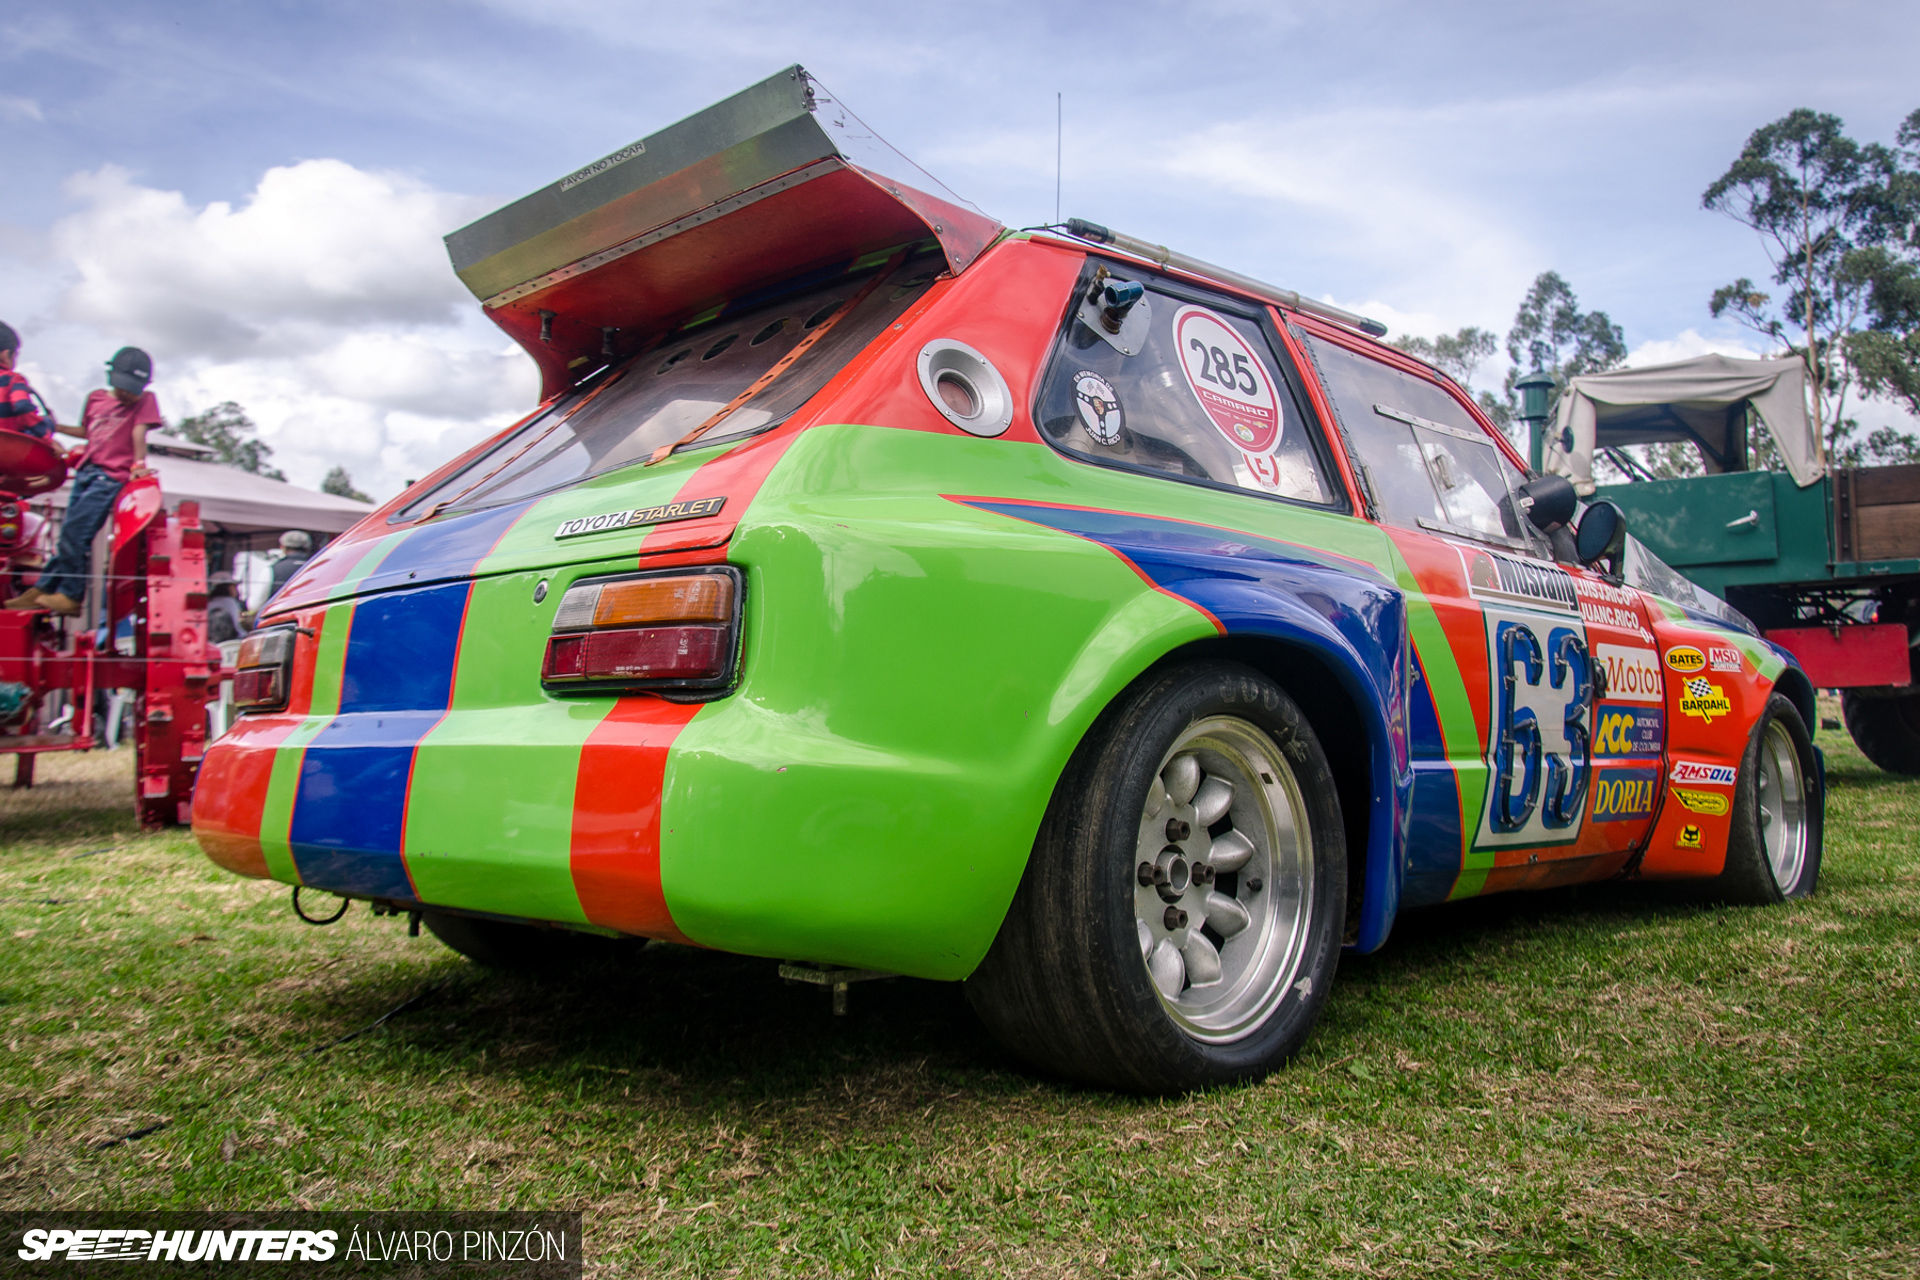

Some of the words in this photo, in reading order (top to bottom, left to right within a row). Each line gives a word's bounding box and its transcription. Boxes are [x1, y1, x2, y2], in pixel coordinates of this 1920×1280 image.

[561, 169, 592, 188] FAVOR
[592, 160, 608, 173] NO
[609, 143, 643, 164] TOCAR
[1190, 338, 1257, 396] 285
[1202, 391, 1269, 418] CAMARO
[1085, 427, 1101, 443] JUAN
[1108, 433, 1121, 445] RICO
[561, 511, 627, 535] TOYOTA
[629, 498, 722, 524] STARLET
[1494, 553, 1580, 612] Mustang
[1670, 654, 1703, 665] BATES
[1713, 649, 1738, 663] MSD
[1606, 656, 1662, 695] Motor
[1682, 699, 1729, 711] BARDAHL
[1489, 620, 1594, 834] 63
[1594, 713, 1635, 754] ACC
[1675, 764, 1733, 782] AMSOIL
[1593, 779, 1654, 815] DORIA
